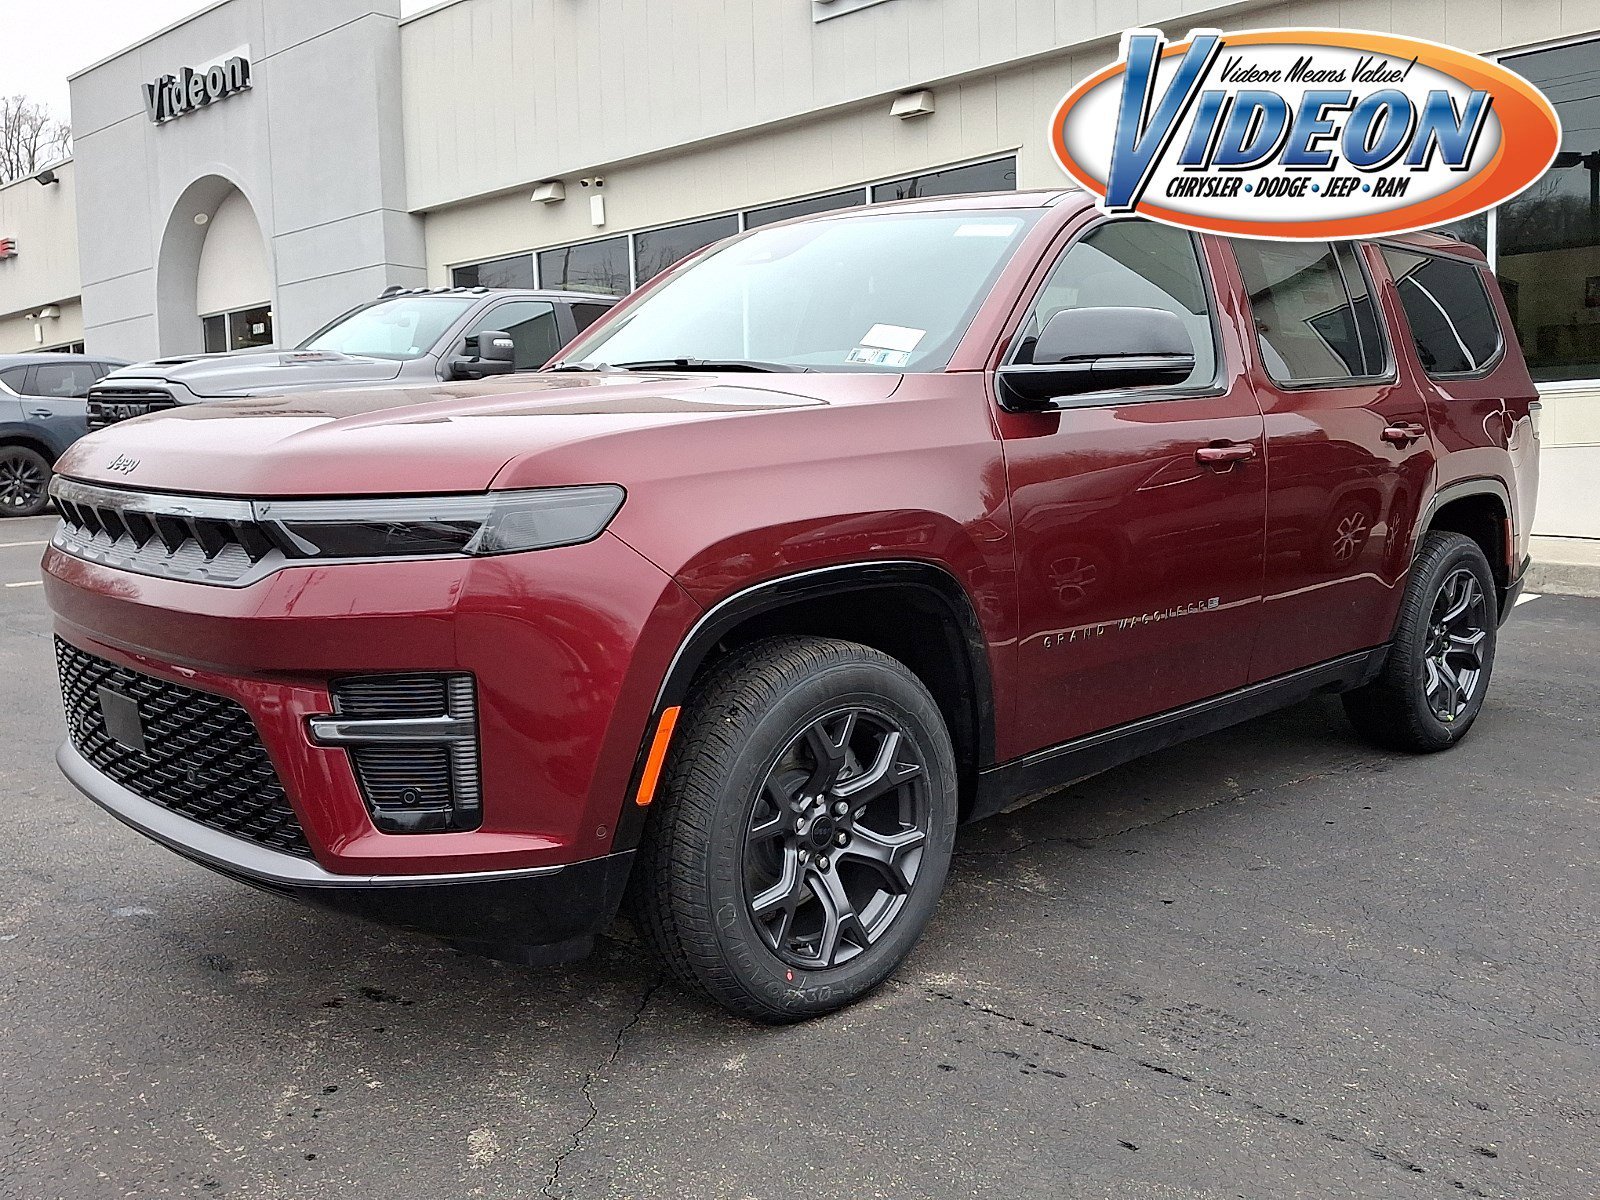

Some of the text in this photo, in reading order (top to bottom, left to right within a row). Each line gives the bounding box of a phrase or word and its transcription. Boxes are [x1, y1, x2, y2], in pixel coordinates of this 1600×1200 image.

[141, 56, 250, 122] Videon
[101, 403, 149, 419] RAM
[106, 453, 141, 475] Jeep
[1043, 624, 1105, 649] GRAND
